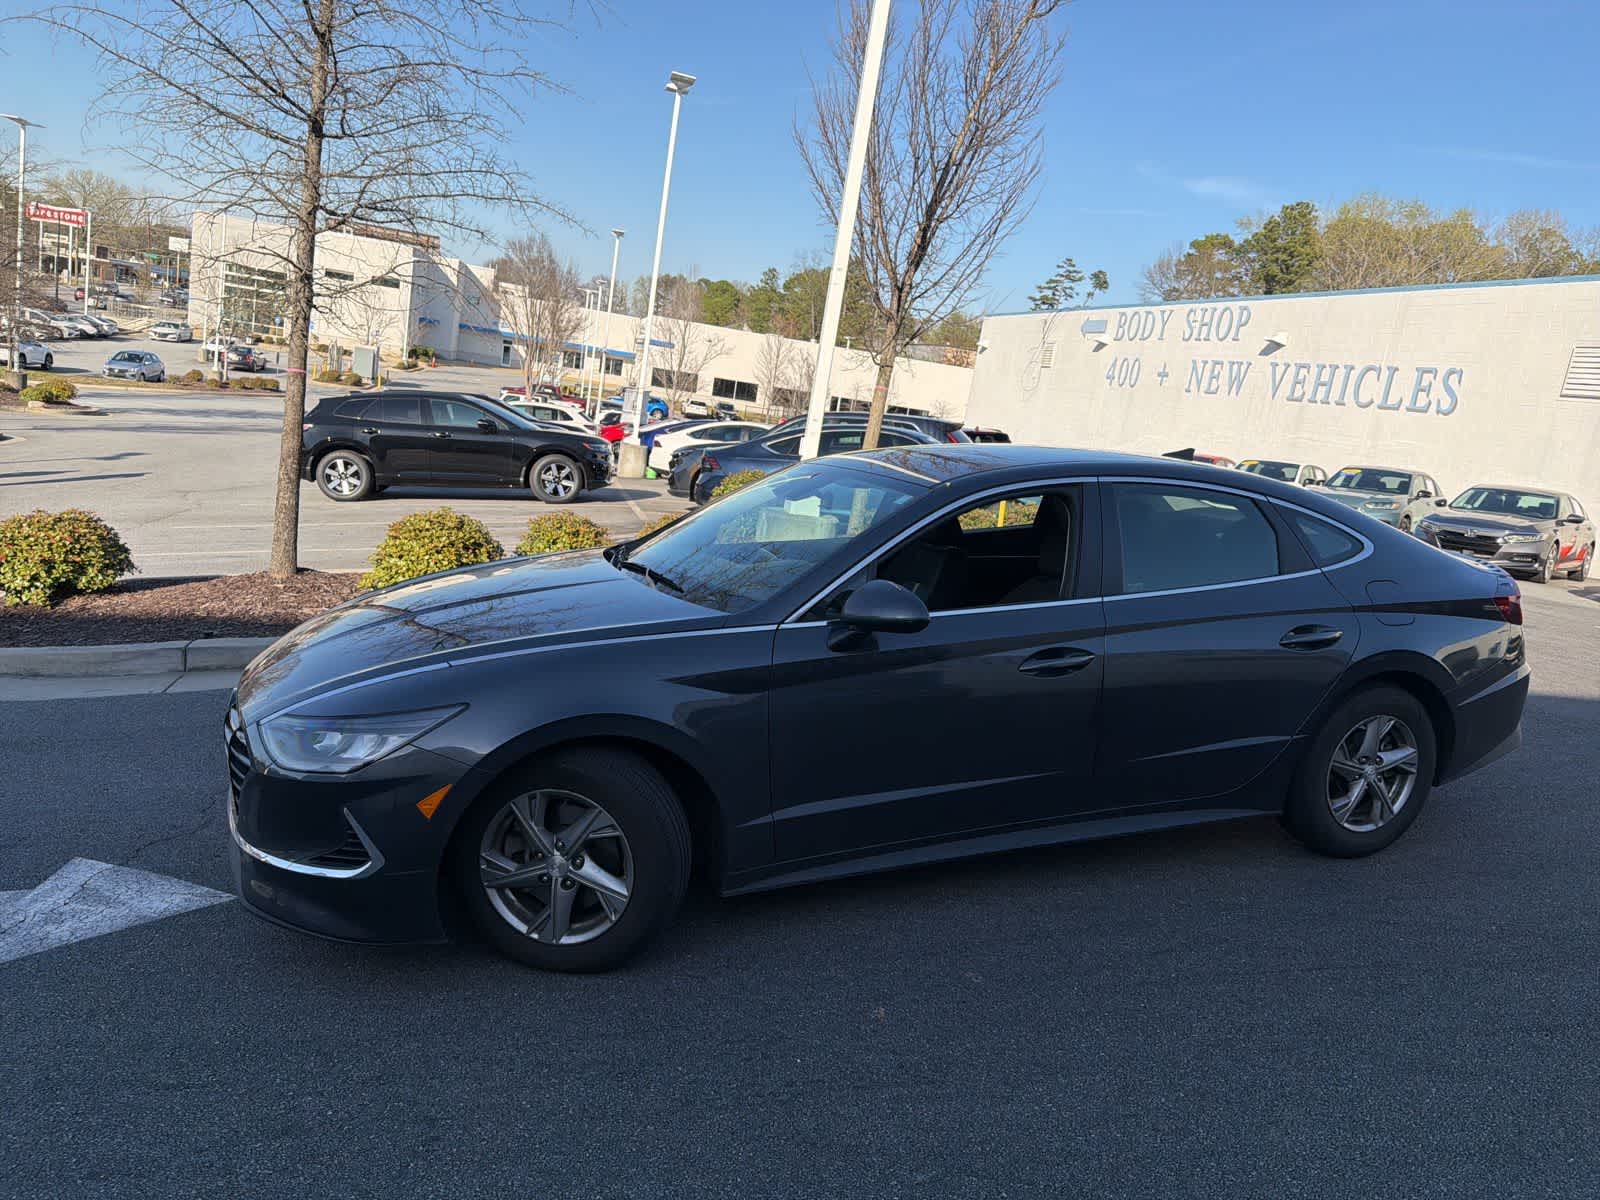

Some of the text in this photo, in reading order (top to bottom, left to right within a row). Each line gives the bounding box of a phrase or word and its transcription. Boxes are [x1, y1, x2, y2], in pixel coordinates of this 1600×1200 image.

[1113, 305, 1251, 342] BODY SHOP
[1105, 356, 1464, 416] 400 + NEW VEHICLES
